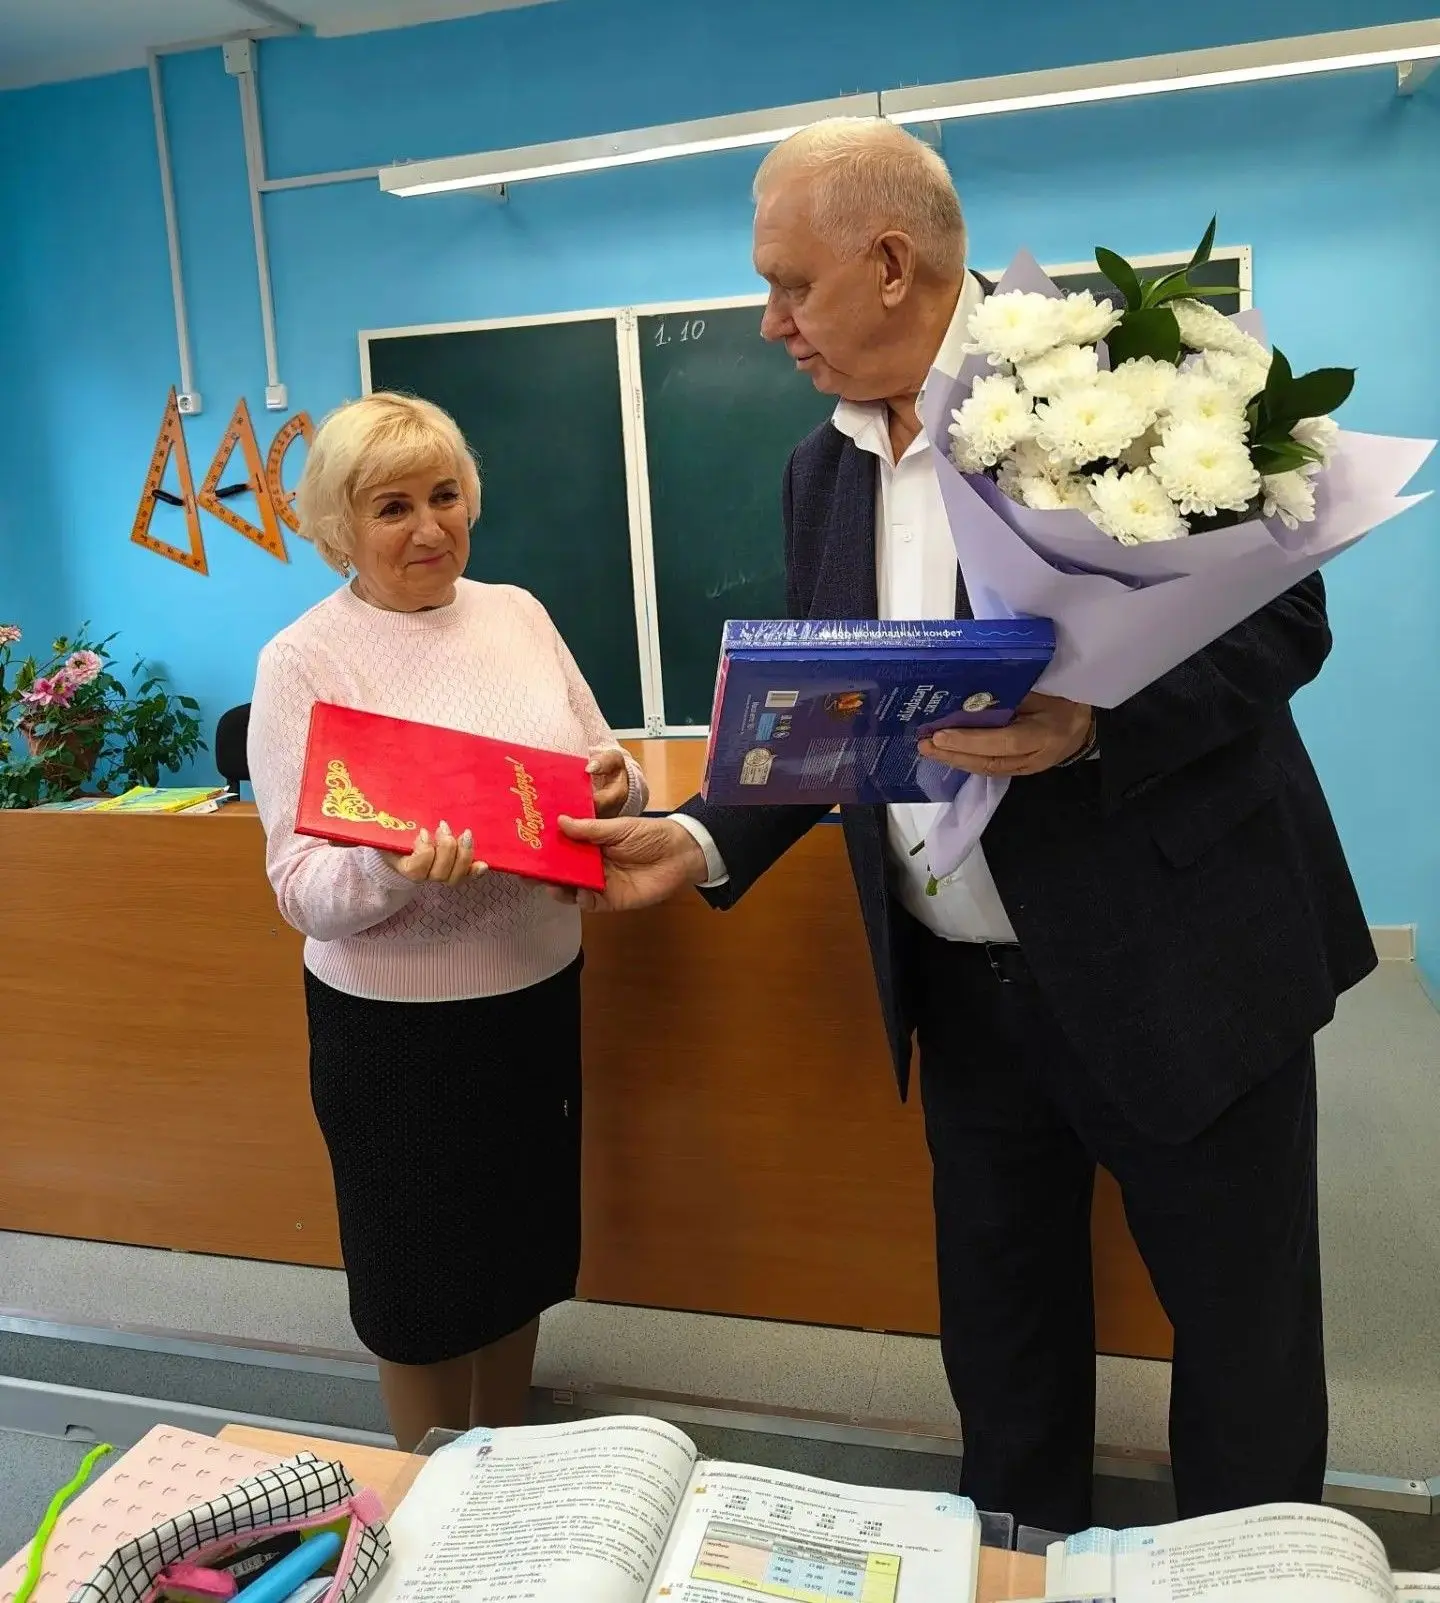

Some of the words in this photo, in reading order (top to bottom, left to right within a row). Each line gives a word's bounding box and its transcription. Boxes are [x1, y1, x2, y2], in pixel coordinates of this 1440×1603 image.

[654, 323, 672, 347] 1.
[680, 320, 705, 342] 10
[853, 629, 921, 640] шоколадных
[924, 628, 962, 639] конфет
[897, 684, 934, 722] Петербург
[923, 690, 949, 716] Санкт-
[935, 1504, 948, 1512] 47
